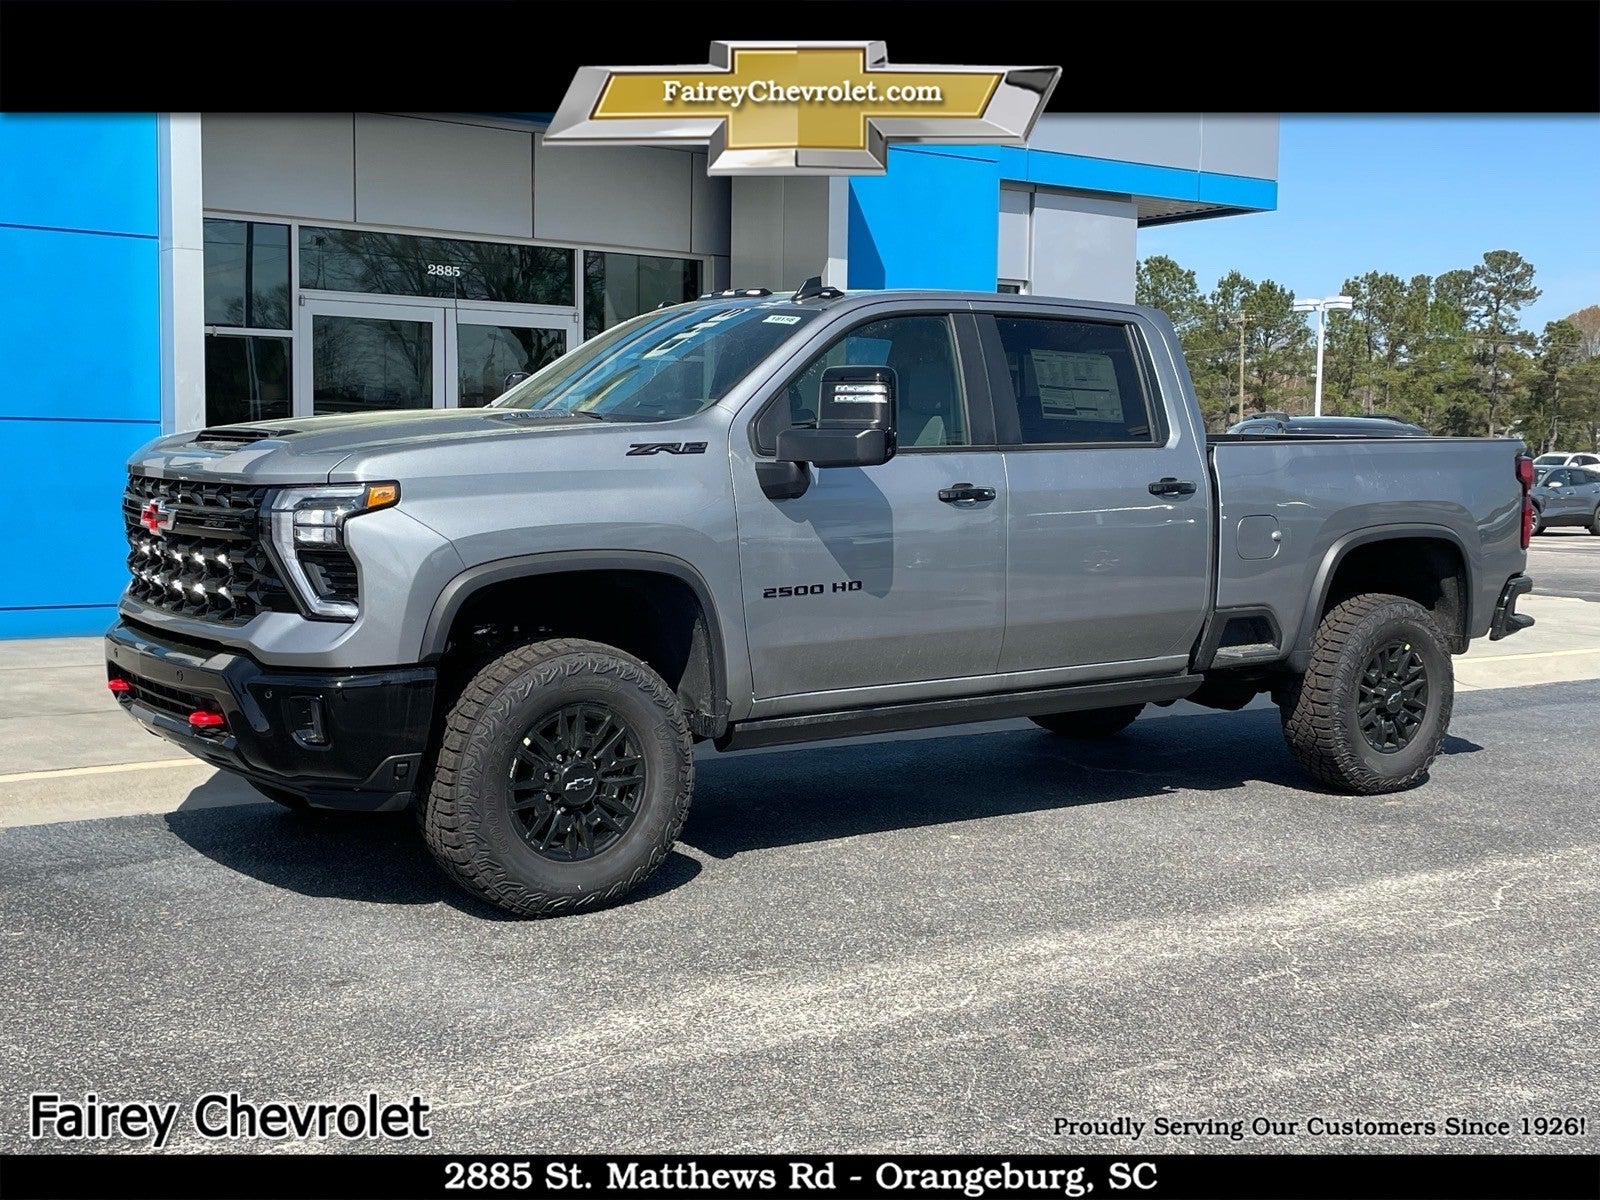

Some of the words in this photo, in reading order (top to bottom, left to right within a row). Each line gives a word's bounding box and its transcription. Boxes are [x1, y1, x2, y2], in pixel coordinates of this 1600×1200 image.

[427, 264, 461, 277] 2885
[625, 441, 709, 457] ZR2
[763, 584, 824, 599] 2500
[832, 580, 863, 593] HD
